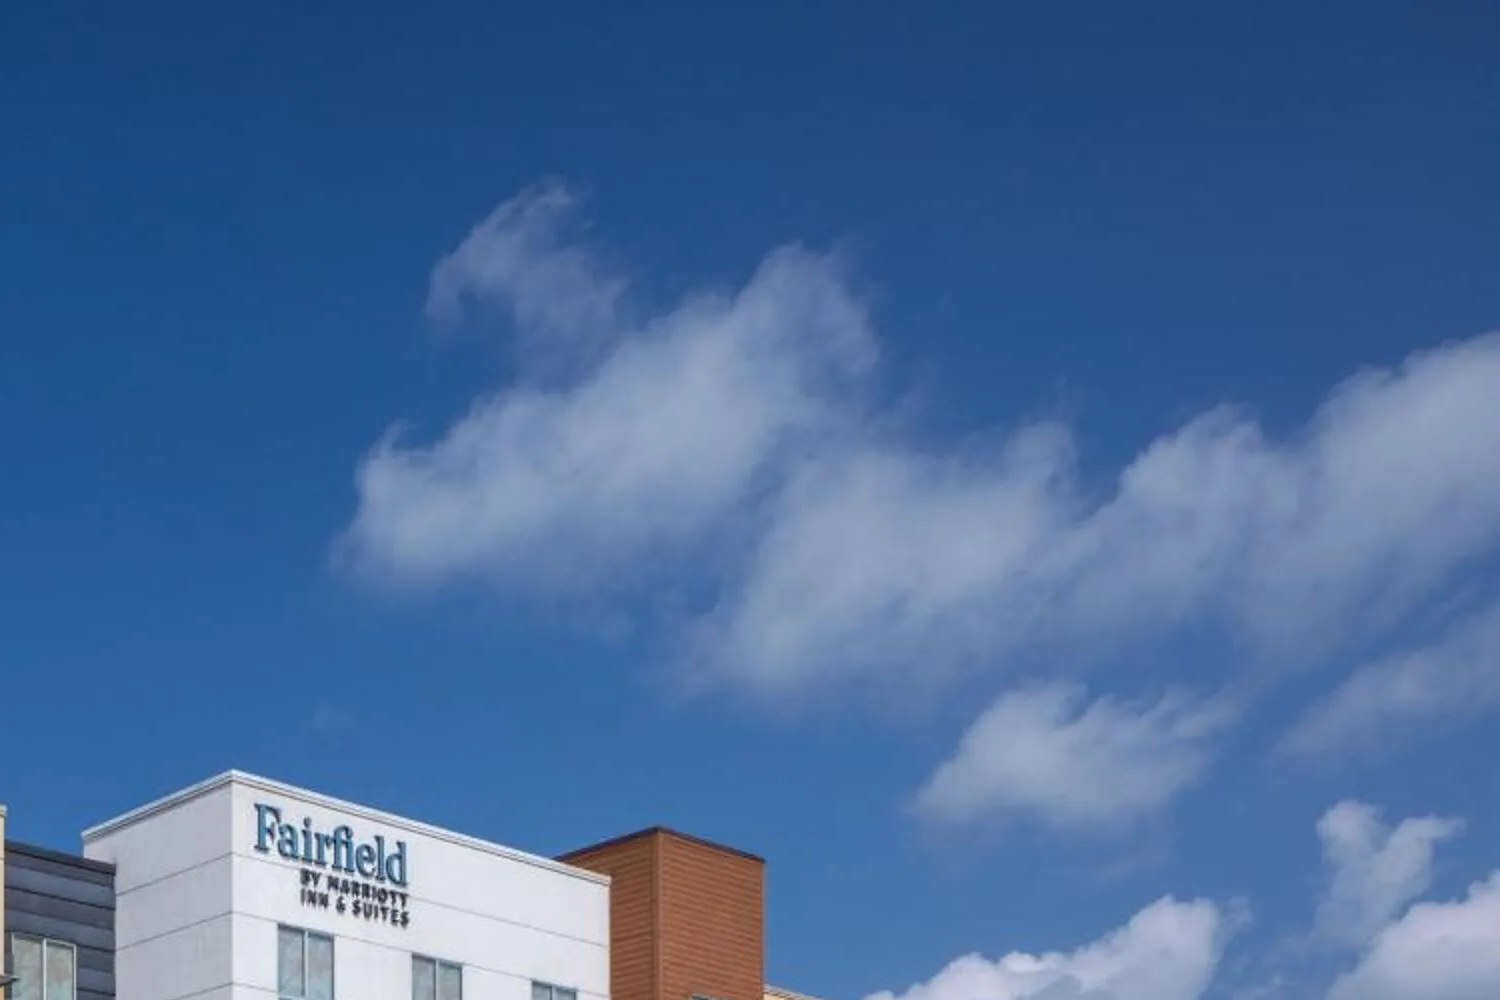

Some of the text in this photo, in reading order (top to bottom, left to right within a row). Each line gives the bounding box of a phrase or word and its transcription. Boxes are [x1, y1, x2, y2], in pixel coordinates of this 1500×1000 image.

[254, 803, 408, 887] Fairfield
[300, 868, 409, 909] BY MARRIOTT
[301, 888, 409, 928] INN & SUITES
